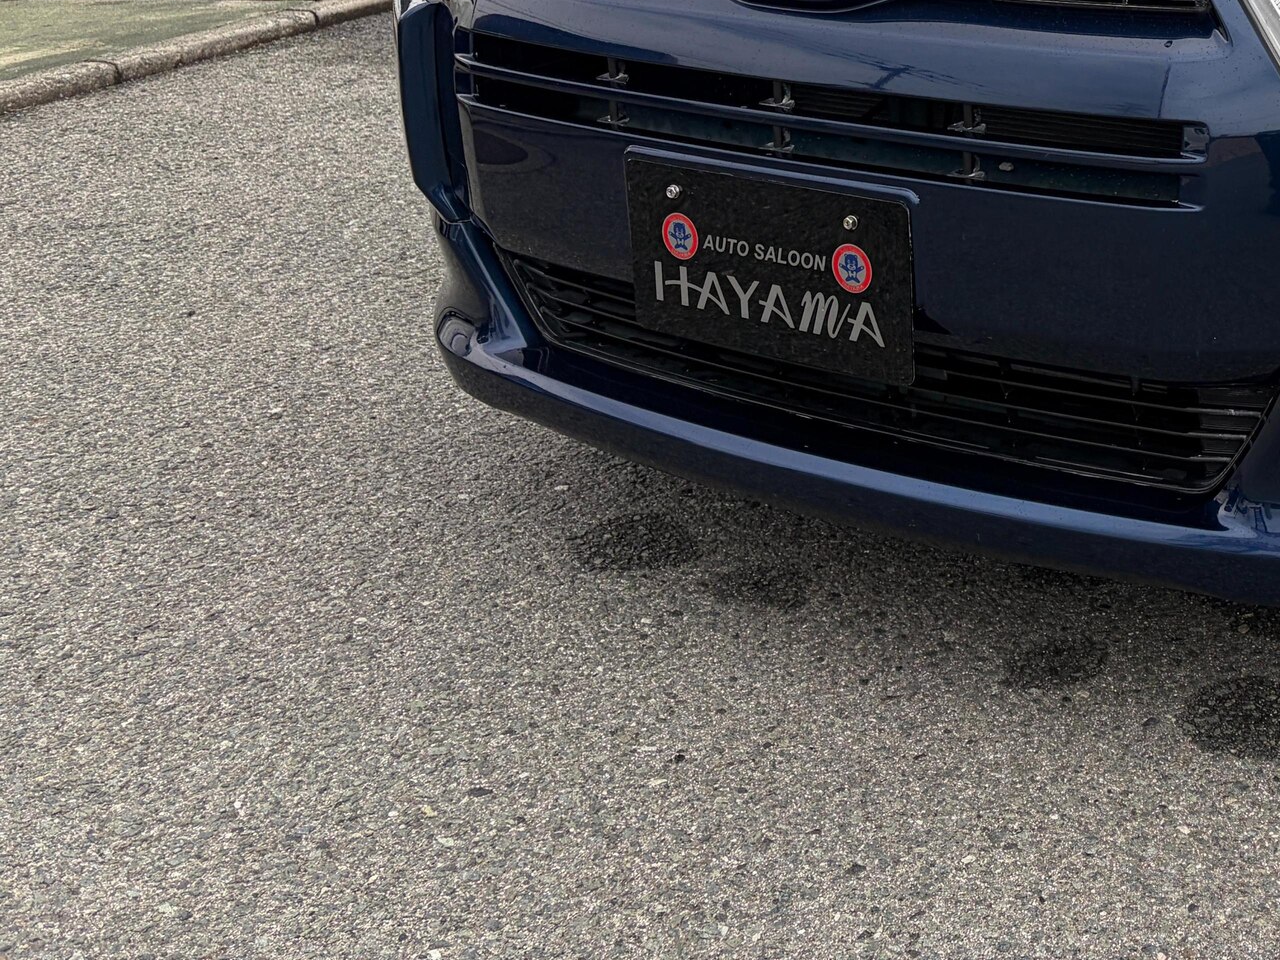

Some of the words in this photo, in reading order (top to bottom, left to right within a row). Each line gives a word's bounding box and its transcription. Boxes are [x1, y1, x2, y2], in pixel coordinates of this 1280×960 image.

[703, 234, 750, 257] AUTO
[754, 244, 827, 272] SALOON
[654, 260, 886, 348] HAYAMA
